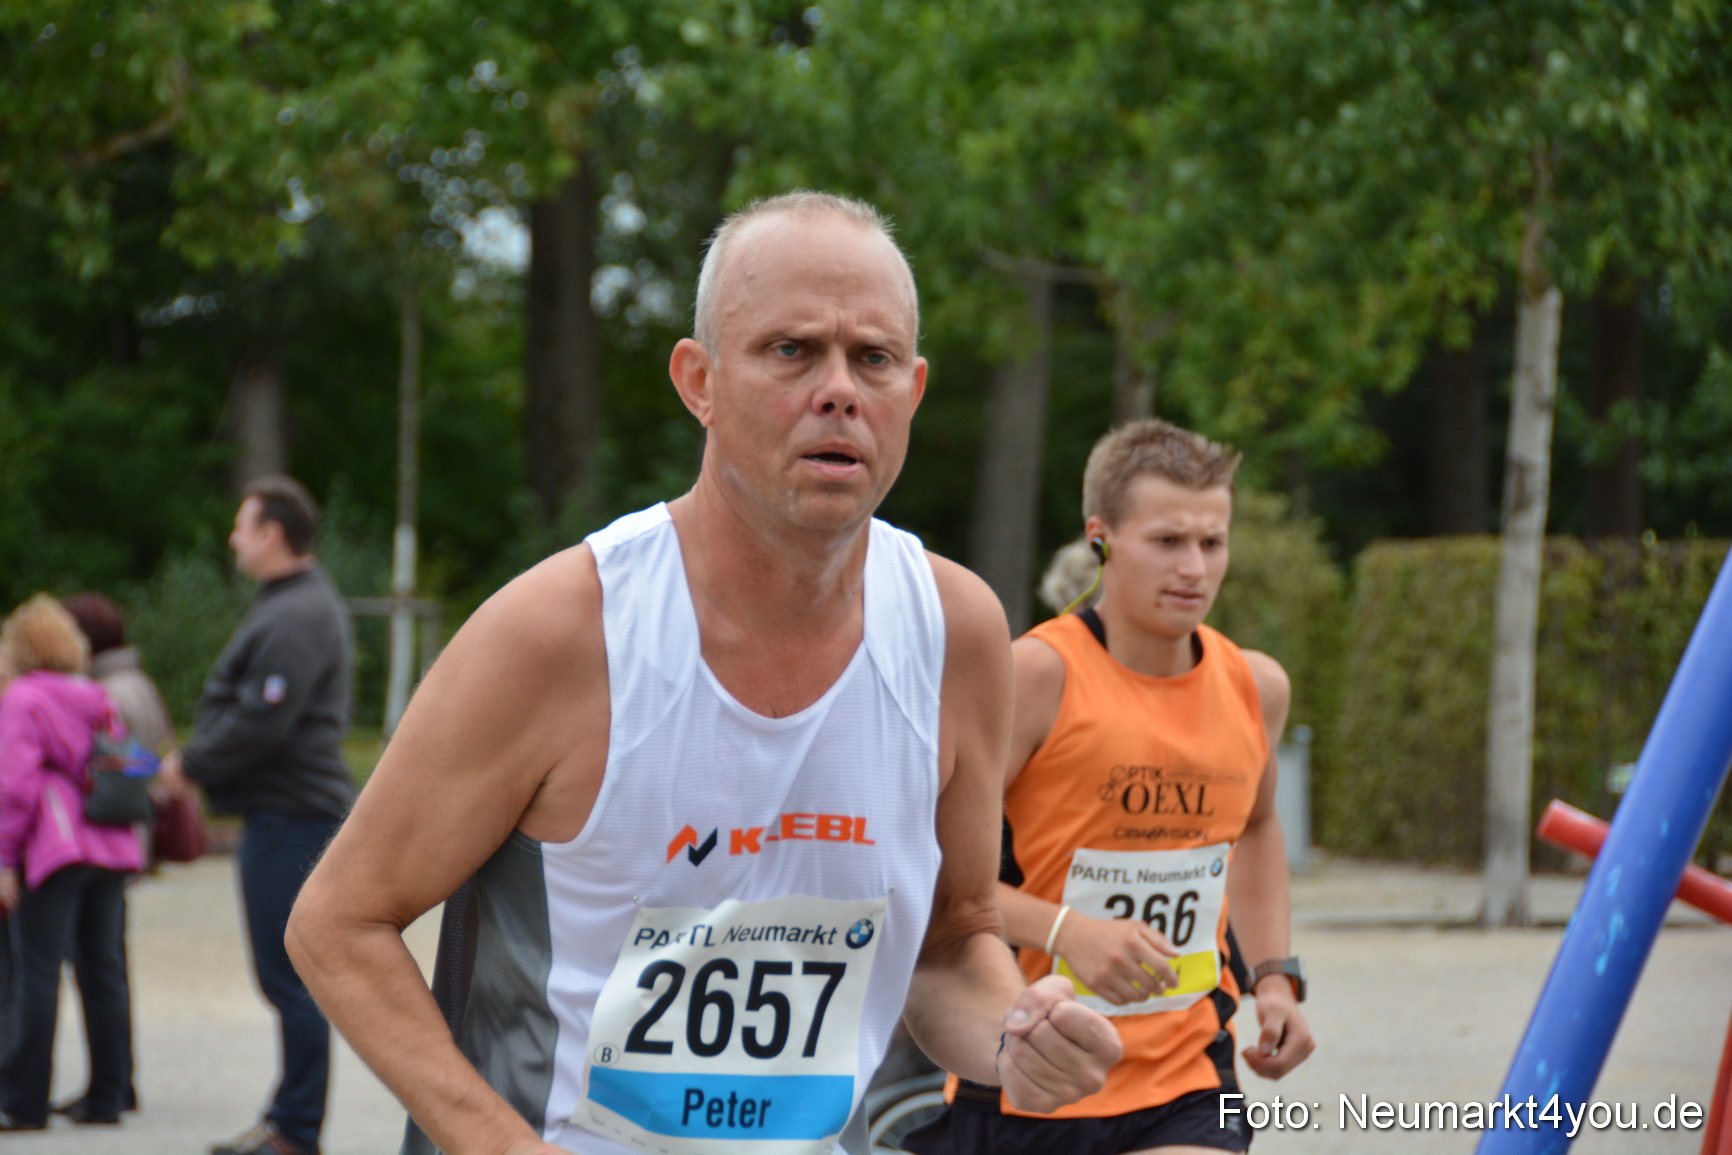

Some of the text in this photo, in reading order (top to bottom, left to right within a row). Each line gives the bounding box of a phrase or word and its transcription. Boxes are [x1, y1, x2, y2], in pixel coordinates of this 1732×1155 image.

[1121, 783, 1214, 816] OEXL
[1071, 864, 1206, 884] PARTL Neumarkt
[721, 923, 838, 945] Neumarkt
[623, 957, 848, 1059] 2657
[600, 1047, 613, 1063] B
[681, 1088, 771, 1128] Peter
